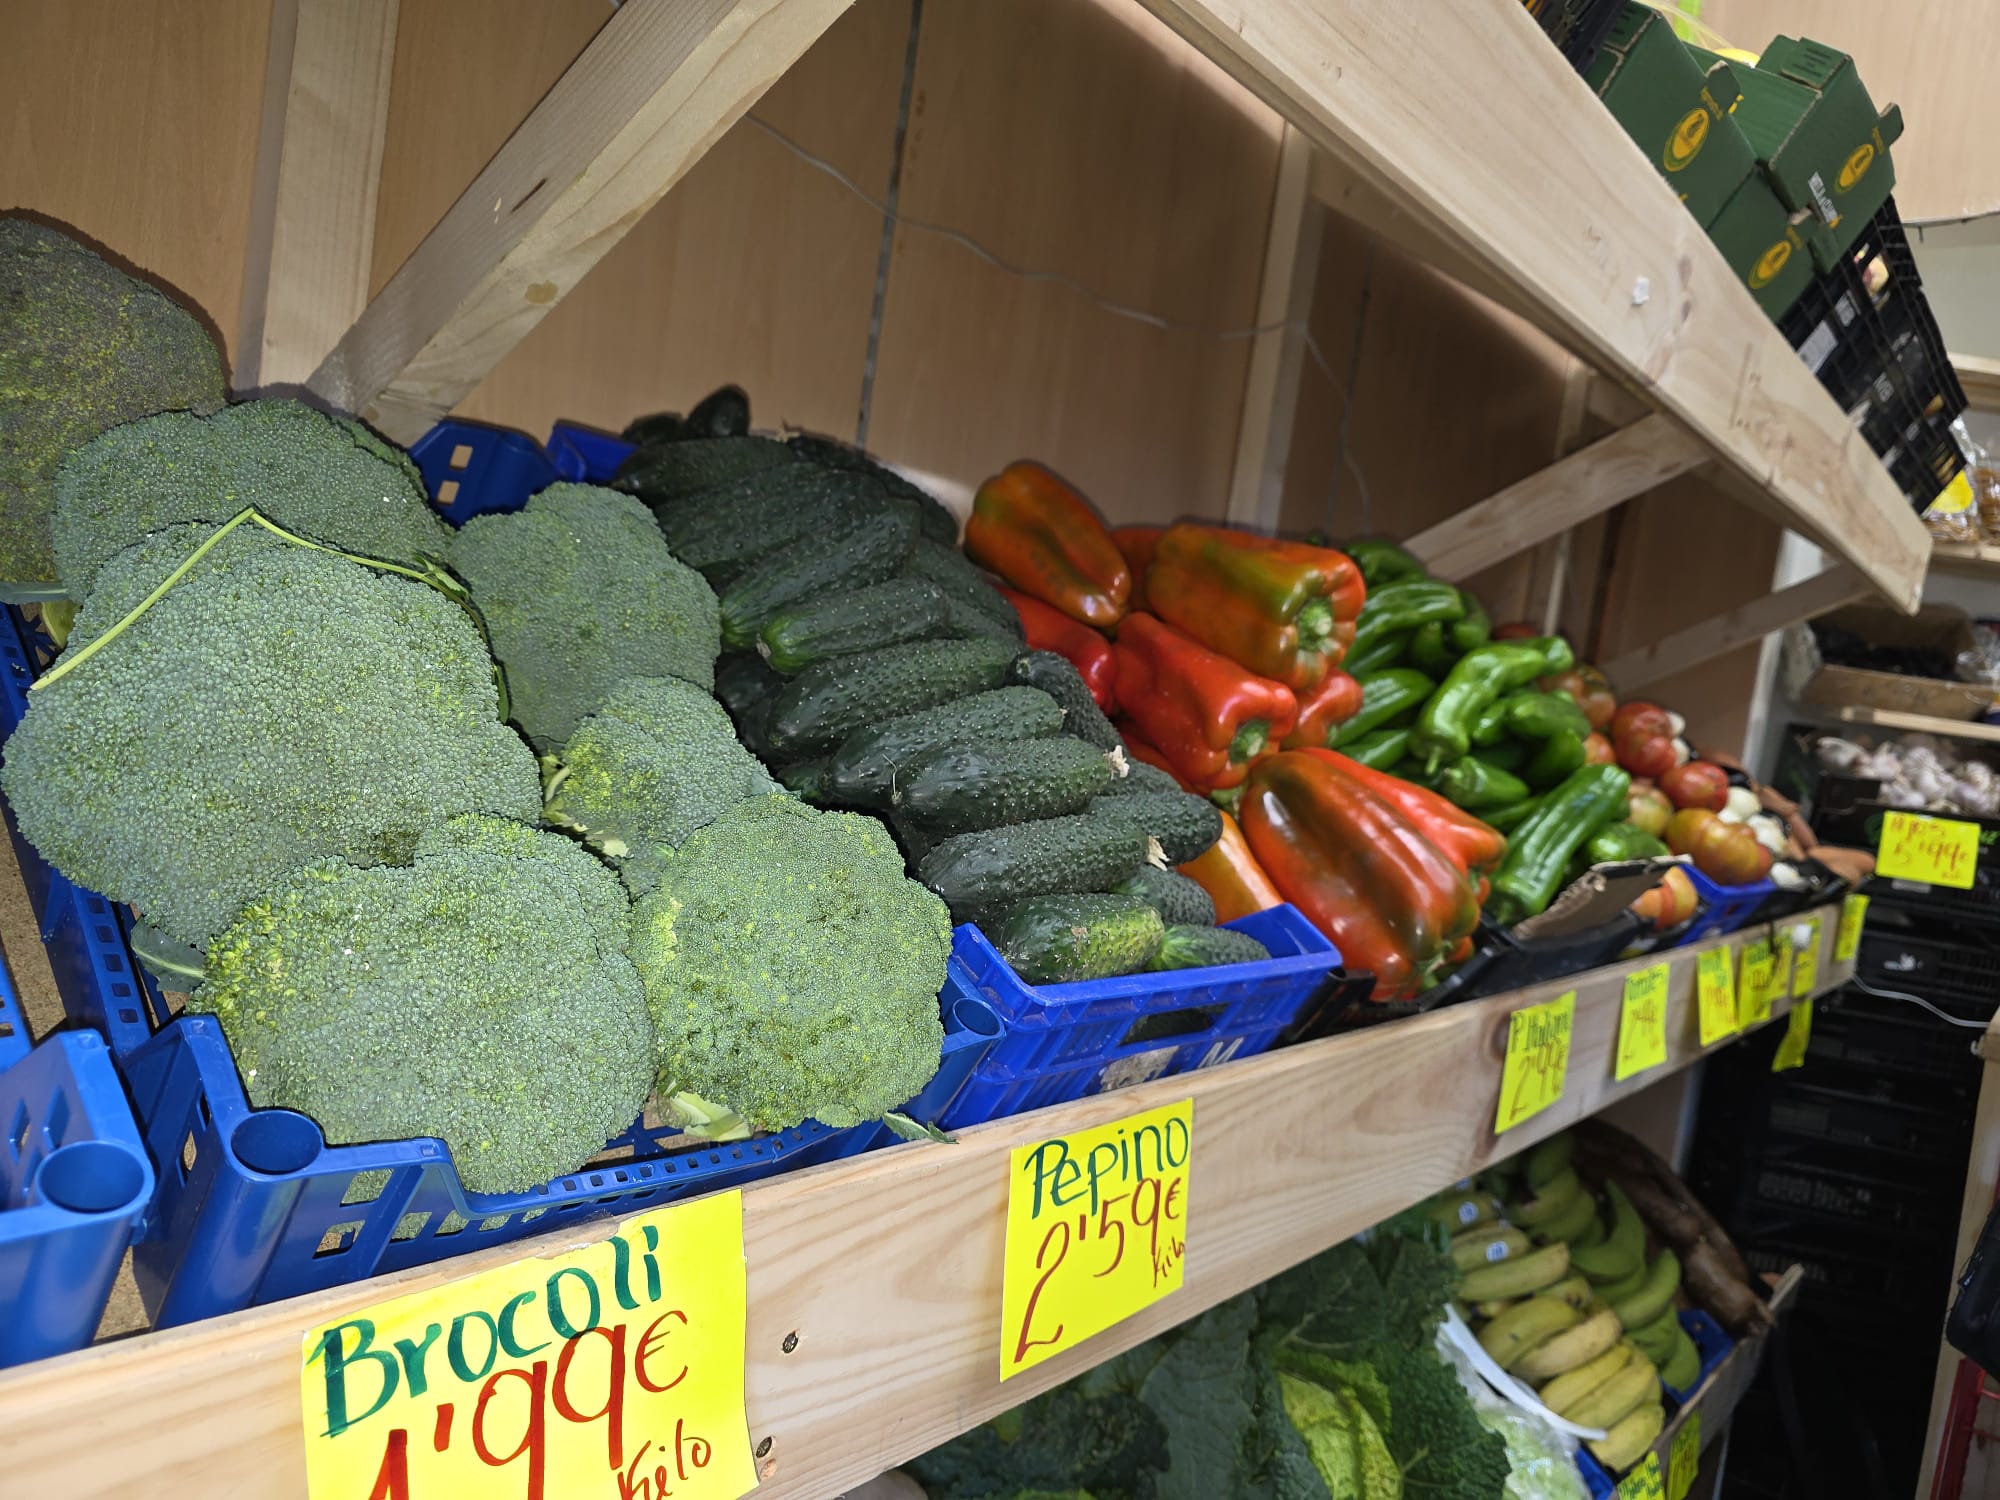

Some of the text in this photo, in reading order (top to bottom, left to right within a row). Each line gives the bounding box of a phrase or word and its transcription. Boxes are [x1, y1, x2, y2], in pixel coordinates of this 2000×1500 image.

[1023, 1116, 1189, 1220] Pepino
[306, 1225, 661, 1438] Brocoli
[1013, 1176, 1182, 1364] 2'59€
